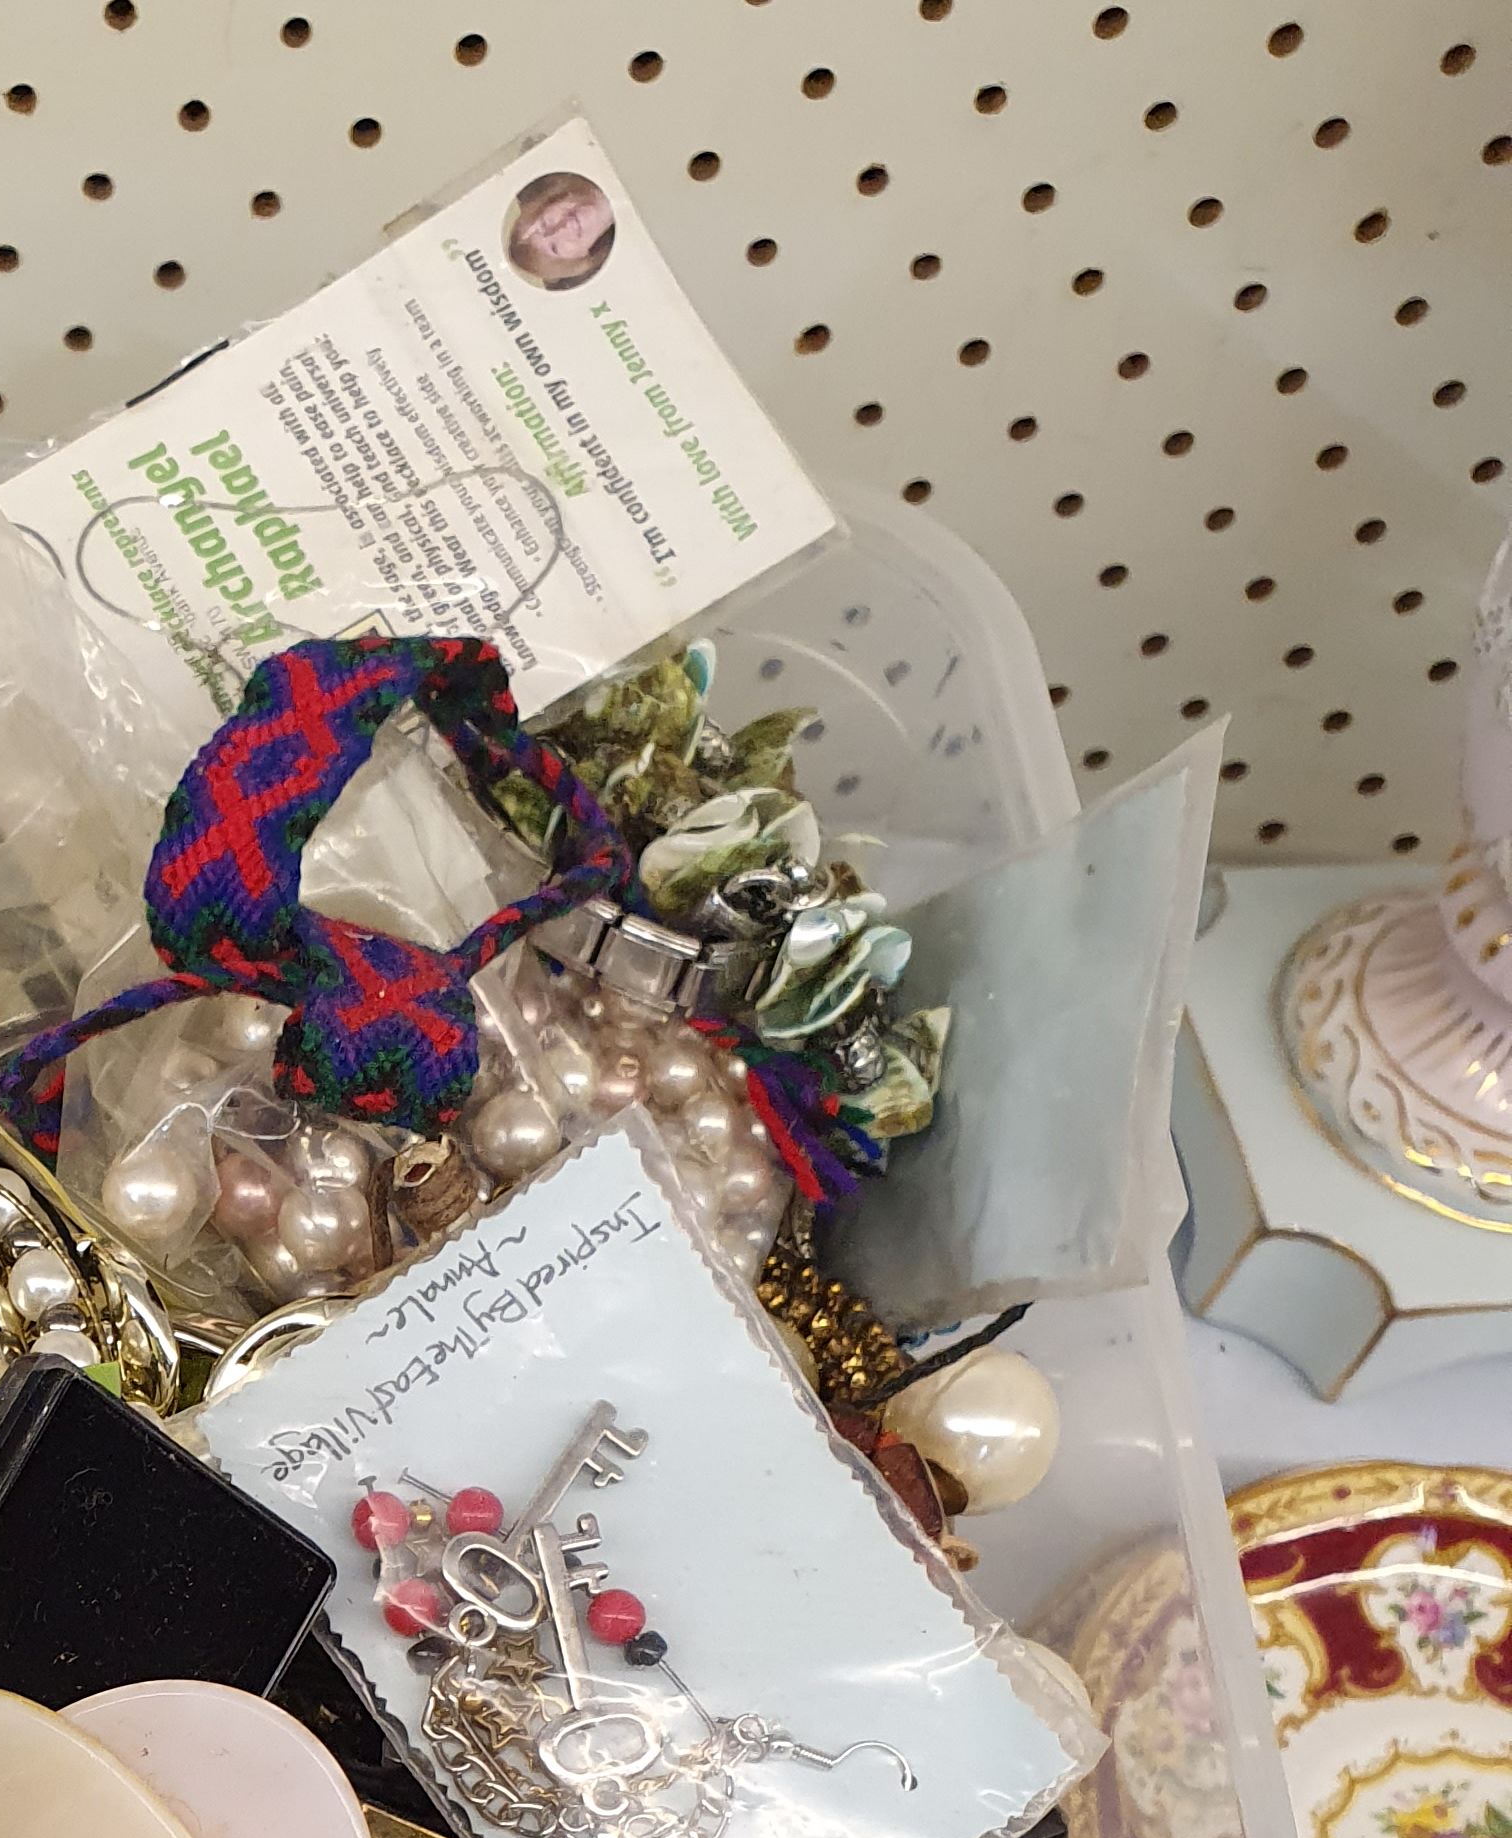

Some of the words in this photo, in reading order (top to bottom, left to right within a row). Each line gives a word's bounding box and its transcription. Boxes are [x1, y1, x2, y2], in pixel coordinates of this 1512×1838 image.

[401, 297, 436, 341] team
[587, 298, 612, 320] x
[433, 348, 454, 370] in
[512, 330, 552, 379] own
[597, 315, 657, 387] Jenny
[274, 356, 315, 405] pain,
[292, 347, 352, 426] universal
[335, 369, 372, 411] help
[362, 345, 422, 425] effectively
[413, 371, 443, 406] side
[444, 363, 494, 431] working
[542, 375, 577, 412] my
[276, 405, 311, 447] with
[302, 401, 335, 441] ease
[361, 408, 382, 430] to
[433, 402, 480, 463] creative
[485, 357, 594, 503] Affirmation:
[562, 410, 590, 438] in
[640, 380, 695, 441] from
[327, 440, 348, 463] to
[342, 423, 382, 472] teach
[411, 421, 458, 482] wisdom
[676, 434, 722, 488] love
[339, 460, 375, 502] help
[575, 431, 652, 528] confident
[187, 424, 329, 605] Raphael
[417, 497, 449, 534] this
[492, 493, 541, 557] Enhance
[708, 482, 759, 543] With
[124, 437, 297, 657] Archangel
[381, 530, 414, 566] and
[394, 502, 454, 579] physical,
[439, 532, 478, 579] Wear
[510, 1185, 663, 1310] Inspired
[363, 1351, 444, 1426] East
[252, 1393, 382, 1493] Village
